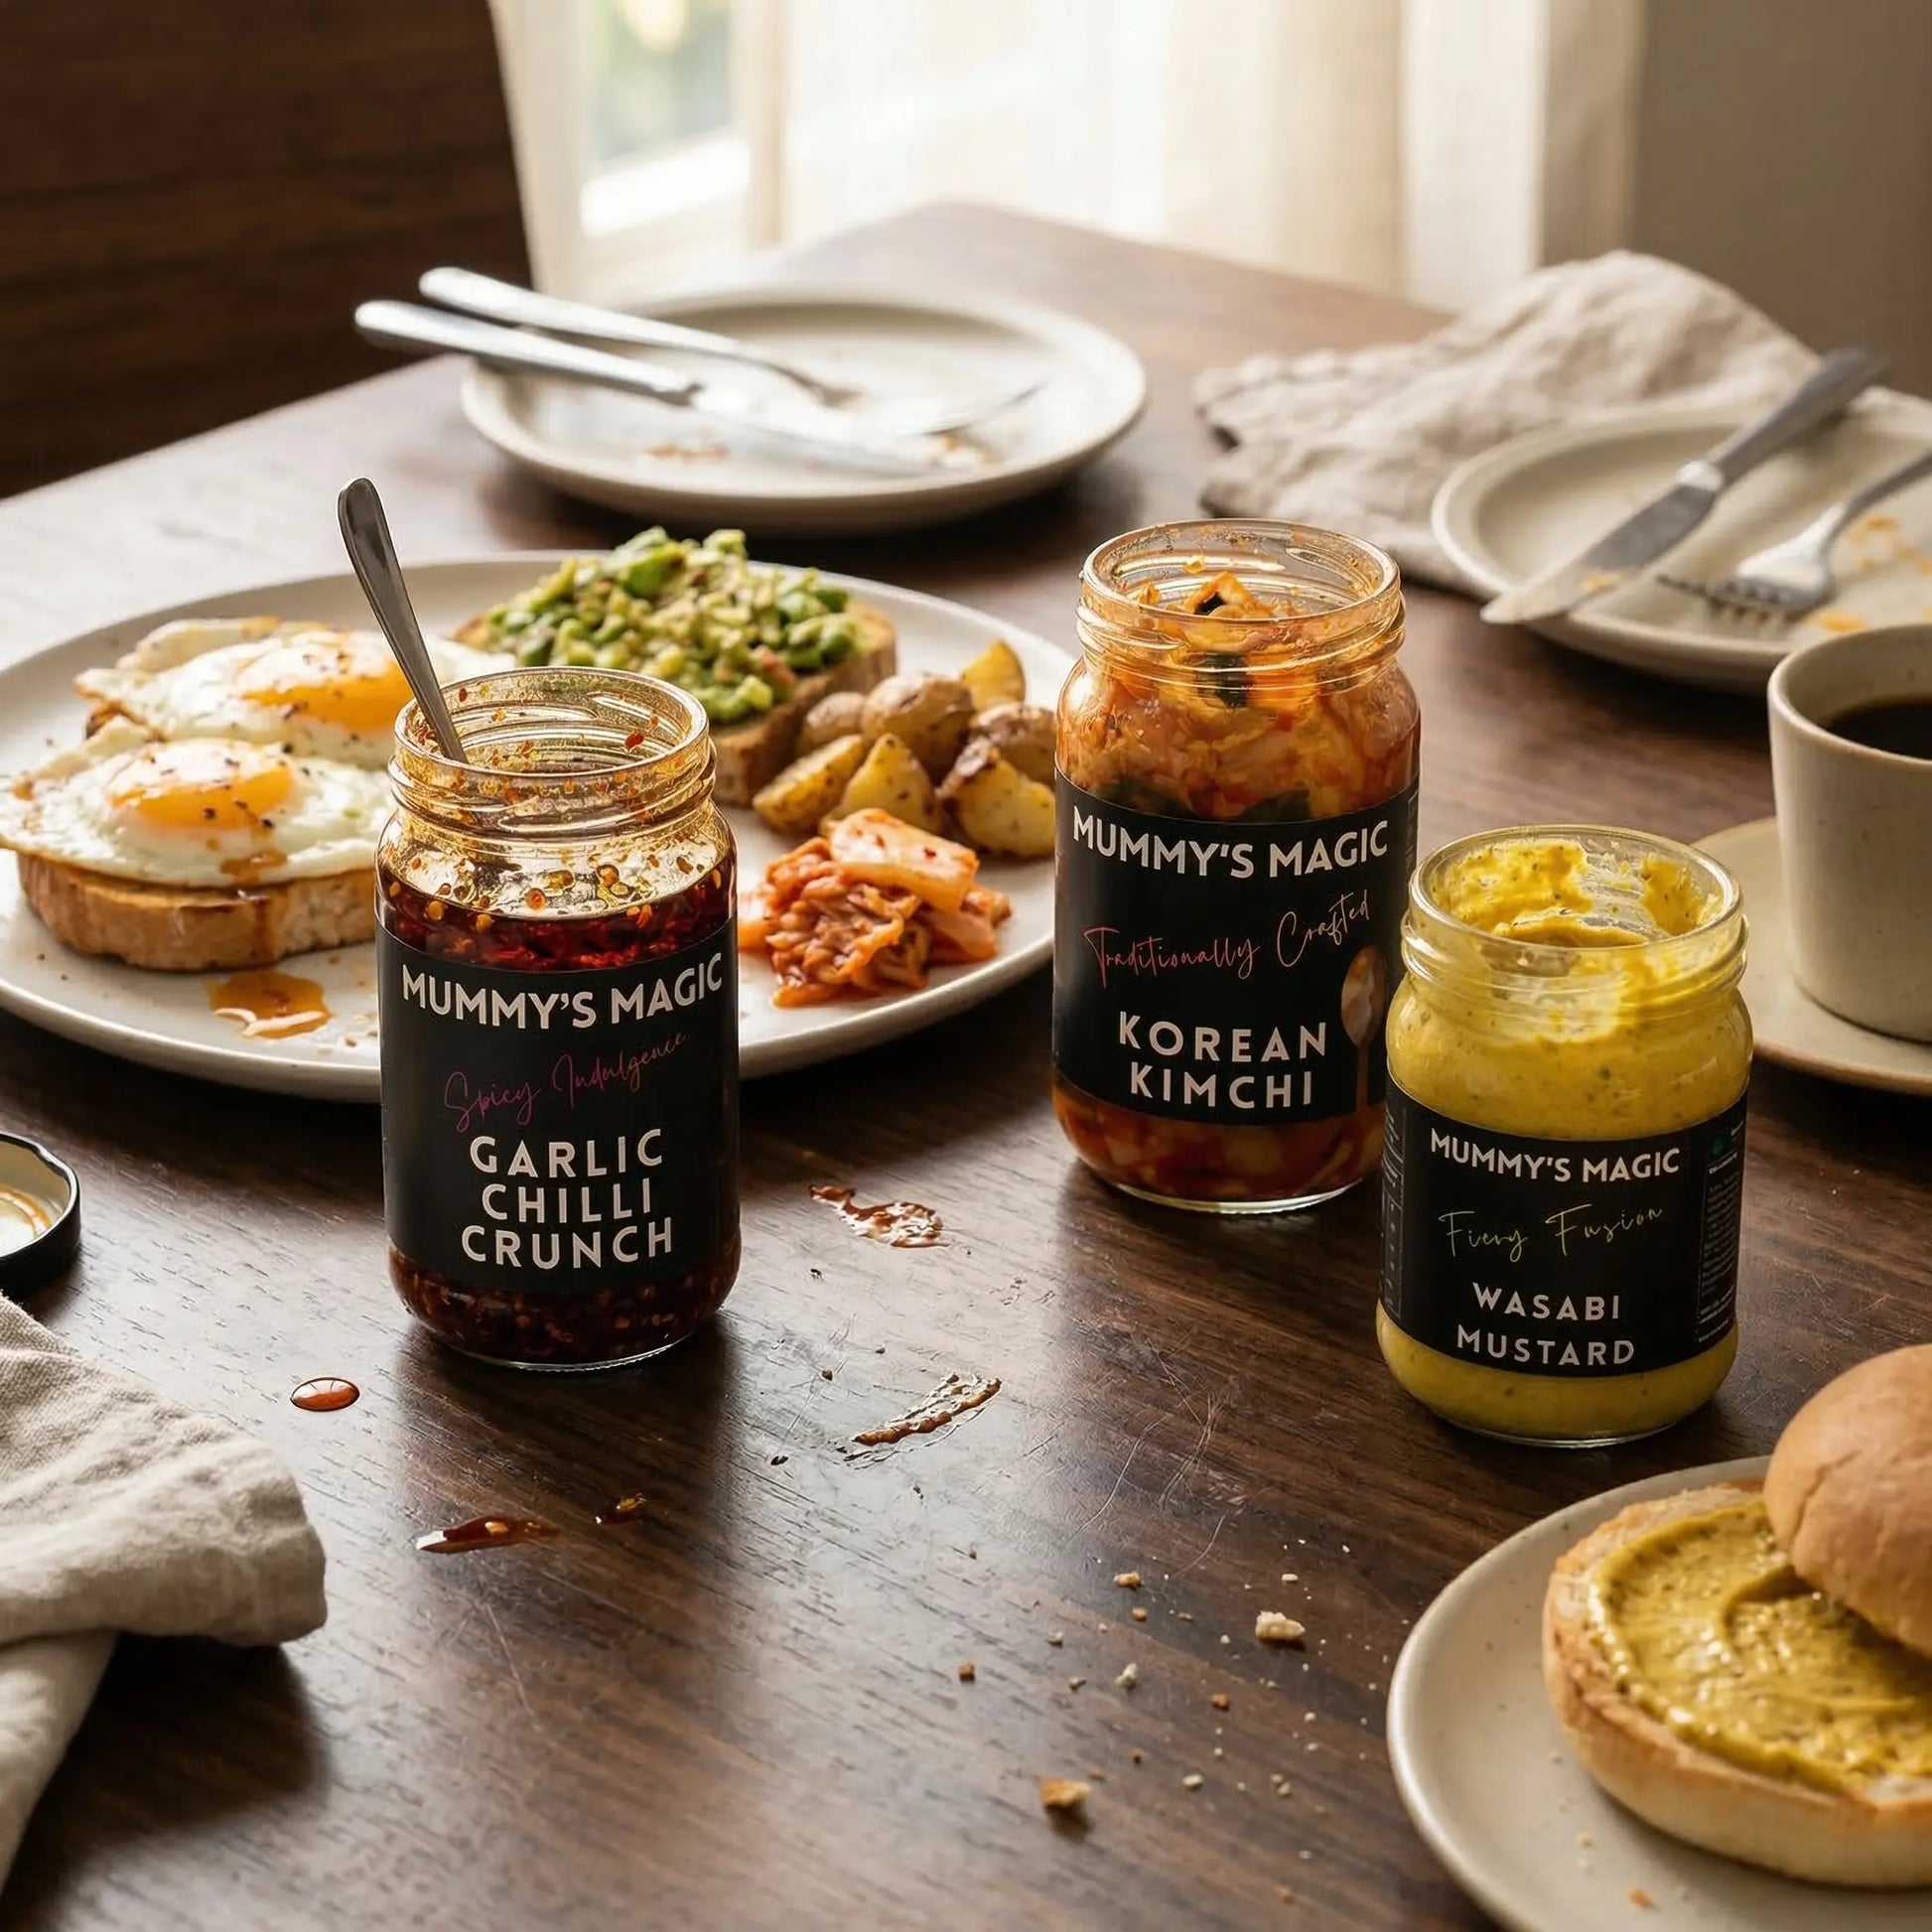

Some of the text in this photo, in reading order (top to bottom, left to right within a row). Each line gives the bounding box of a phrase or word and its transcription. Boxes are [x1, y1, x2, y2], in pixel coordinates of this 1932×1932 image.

[1072, 805, 1254, 879] MUMMY'S
[1269, 820, 1388, 878] MAGIC
[1083, 889, 1370, 990] Traditionally Crafted
[402, 952, 723, 1029] MUMMY'S MAGIC
[1119, 1011, 1326, 1063] KOREAN
[443, 1033, 687, 1132] Spicy Indulgence
[1130, 1061, 1312, 1109] KIMCHI
[470, 1129, 663, 1178] GARLIC
[1431, 1128, 1572, 1181] MUMMY'S
[1583, 1148, 1681, 1182] MAGIC
[482, 1177, 652, 1224] CHILLI
[461, 1217, 672, 1270] CRUNCH
[1439, 1210, 1529, 1263] Fiery
[1472, 1282, 1620, 1321] WASABI
[1456, 1324, 1635, 1366] MUSTARD
